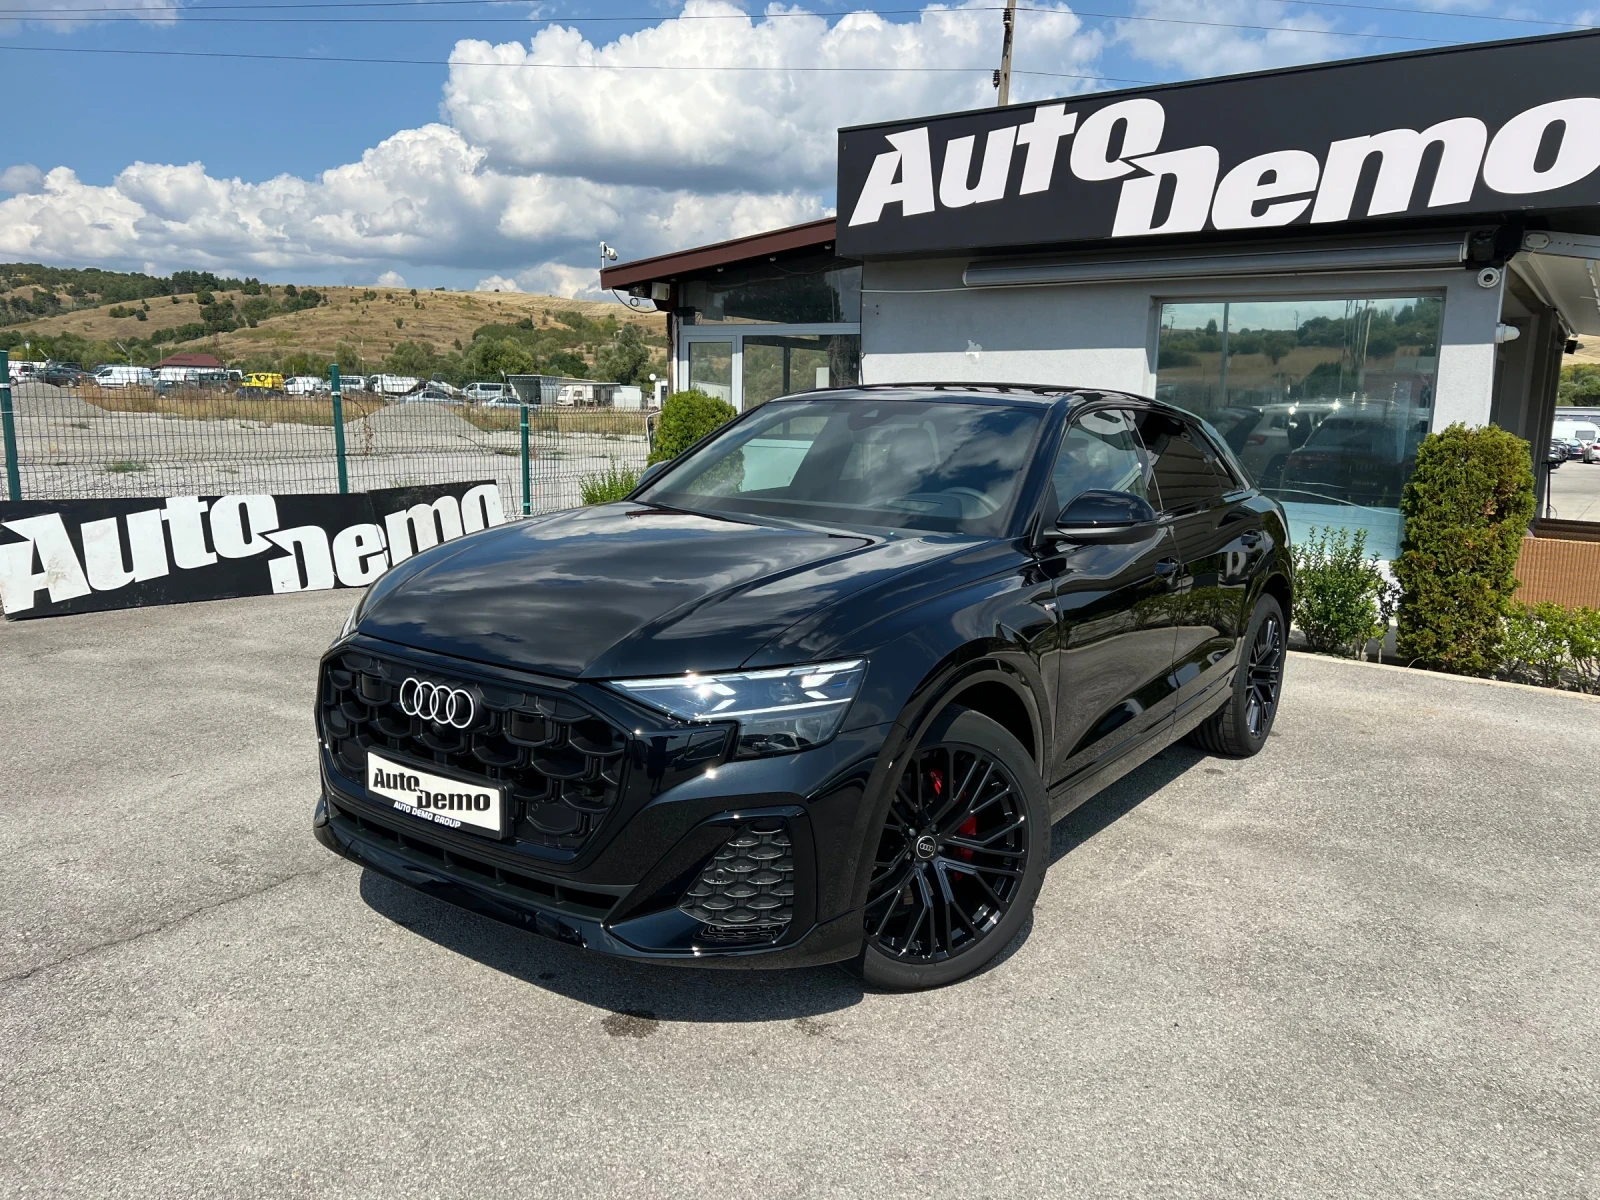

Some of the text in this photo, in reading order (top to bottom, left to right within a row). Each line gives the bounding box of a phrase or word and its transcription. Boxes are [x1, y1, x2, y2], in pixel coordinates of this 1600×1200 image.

[848, 97, 1600, 238] Auto Demo
[0, 484, 505, 614] Auto Demo
[373, 767, 491, 812] Auto Demo
[393, 801, 462, 829] AUTO DEMO GROUP
